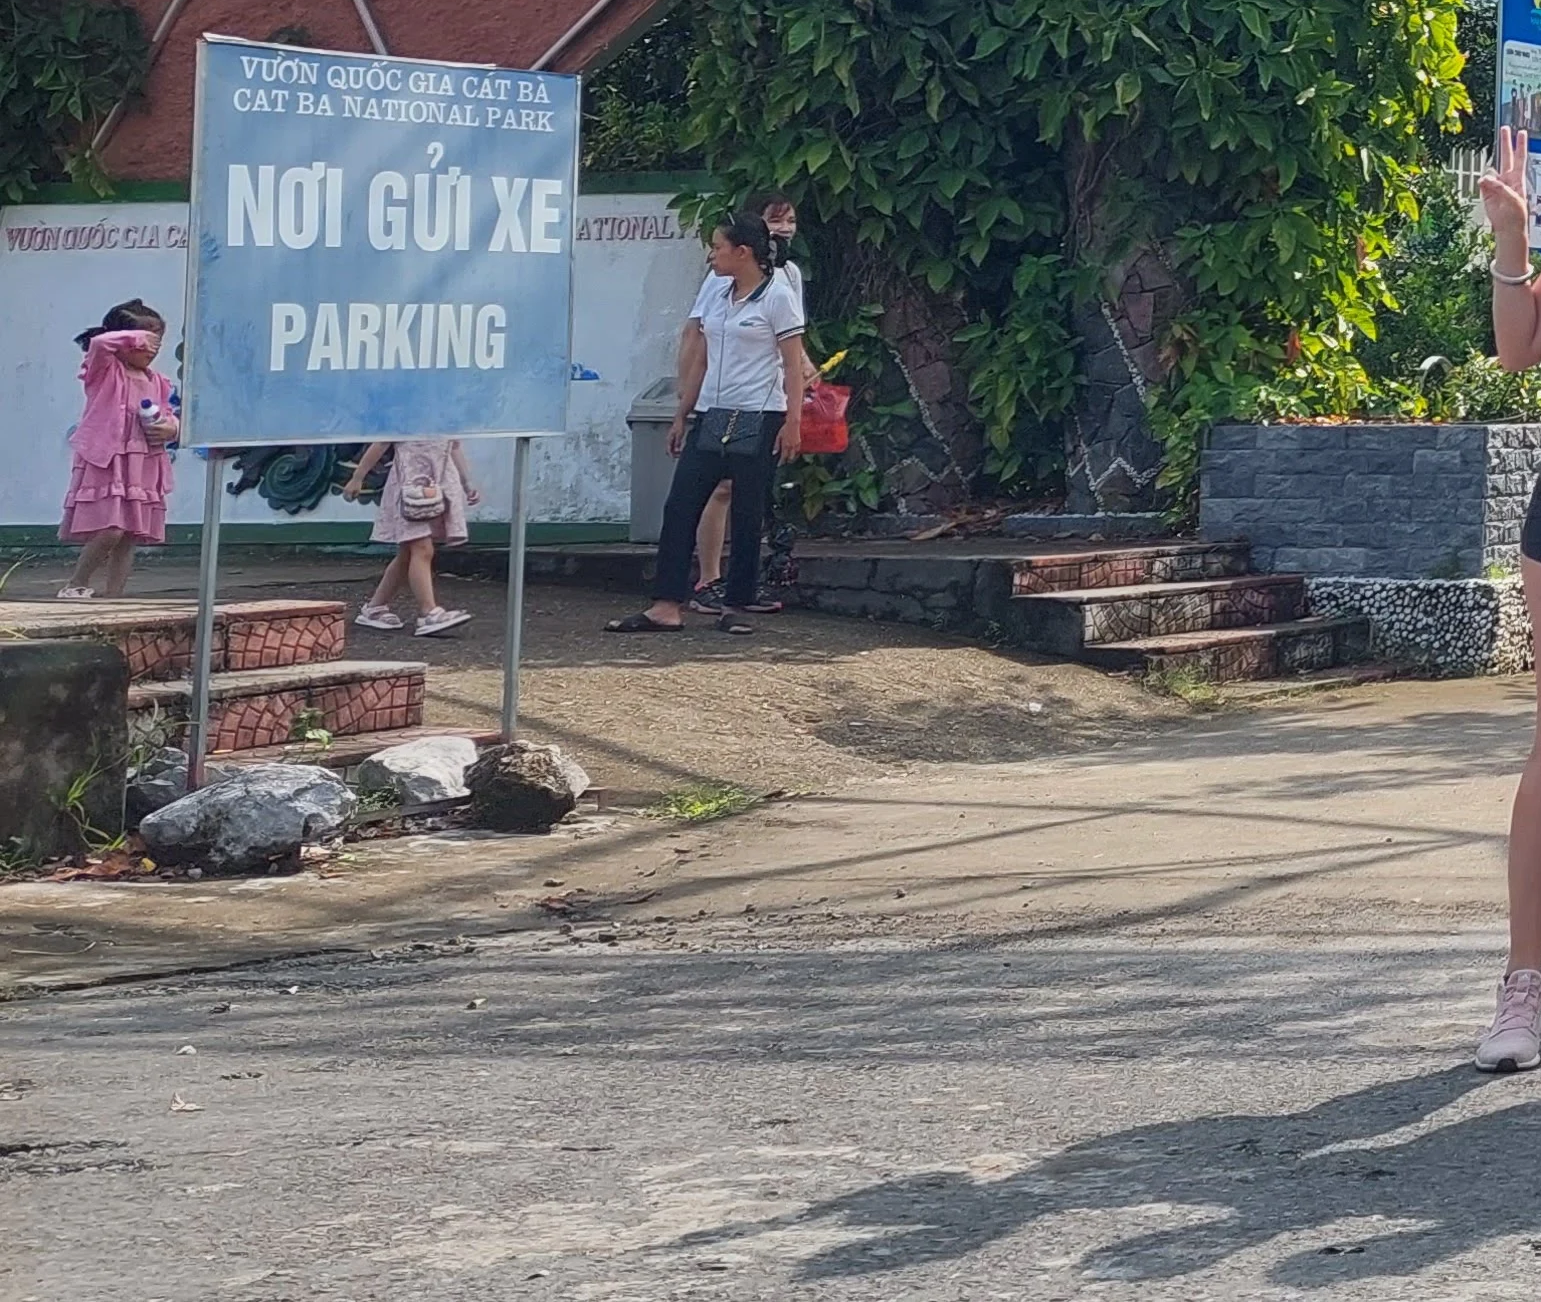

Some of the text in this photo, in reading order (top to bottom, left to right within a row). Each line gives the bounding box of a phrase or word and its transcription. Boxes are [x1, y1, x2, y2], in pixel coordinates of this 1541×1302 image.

[240, 51, 551, 104] VƯỜN QUỐC GIA CÁT BÀ
[233, 88, 555, 132] CAT BA NATIONAL PARK
[227, 141, 563, 254] NƠI GỬI XE
[575, 215, 676, 241] ATIONAL
[270, 302, 507, 371] PARKING
